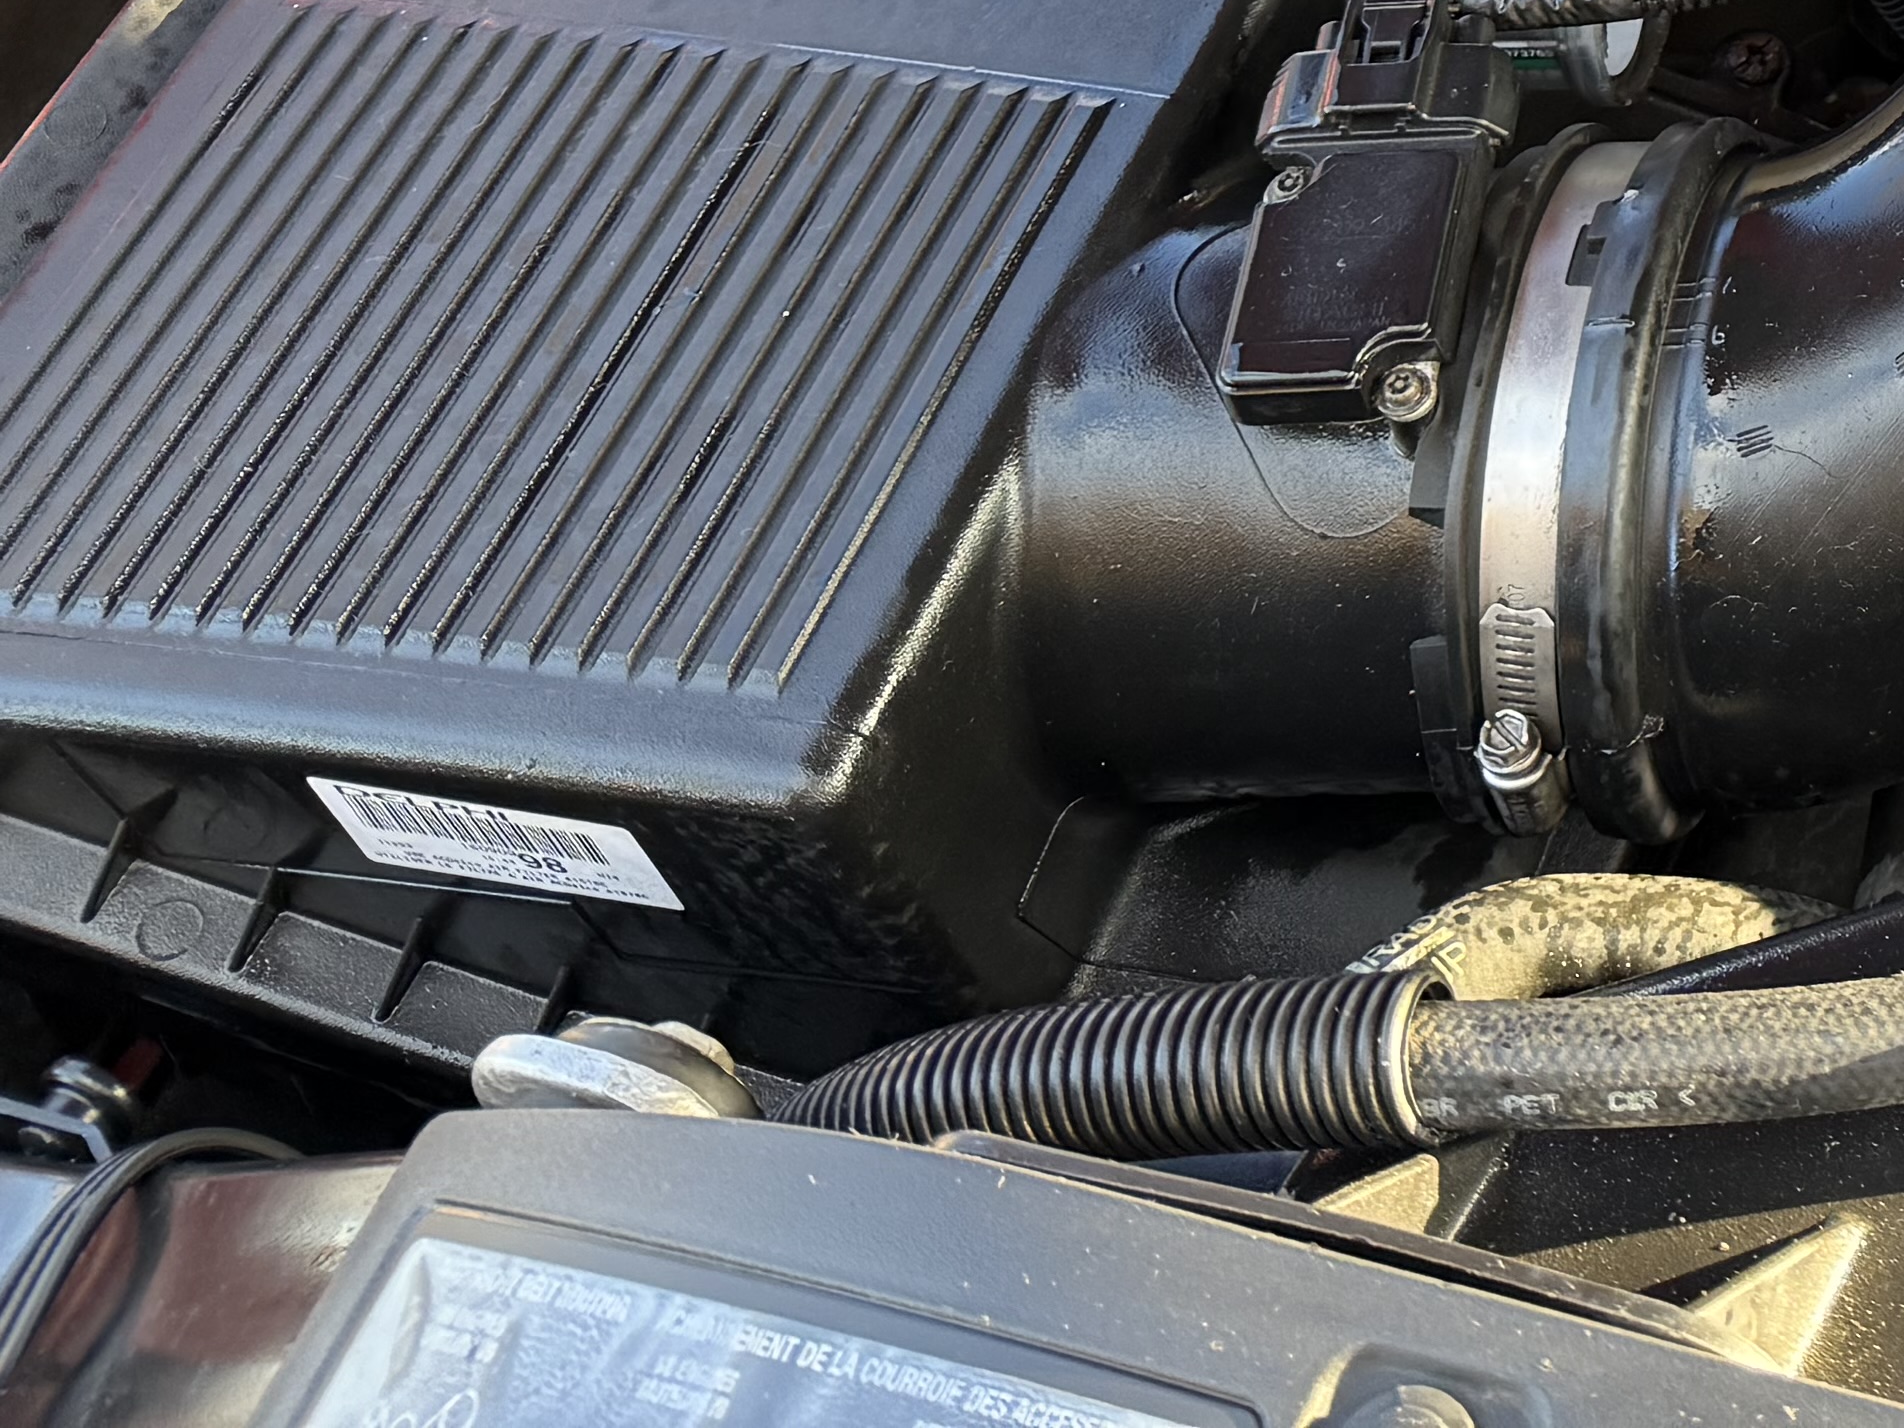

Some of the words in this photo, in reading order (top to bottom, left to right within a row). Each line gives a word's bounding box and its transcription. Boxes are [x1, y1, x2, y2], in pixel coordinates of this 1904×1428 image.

[517, 852, 569, 874] 98
[1502, 1093, 1561, 1115] PET
[797, 1340, 827, 1373] DE
[827, 1349, 858, 1381] LA
[860, 1355, 968, 1410] COURROIE
[966, 1383, 1010, 1418] DES
